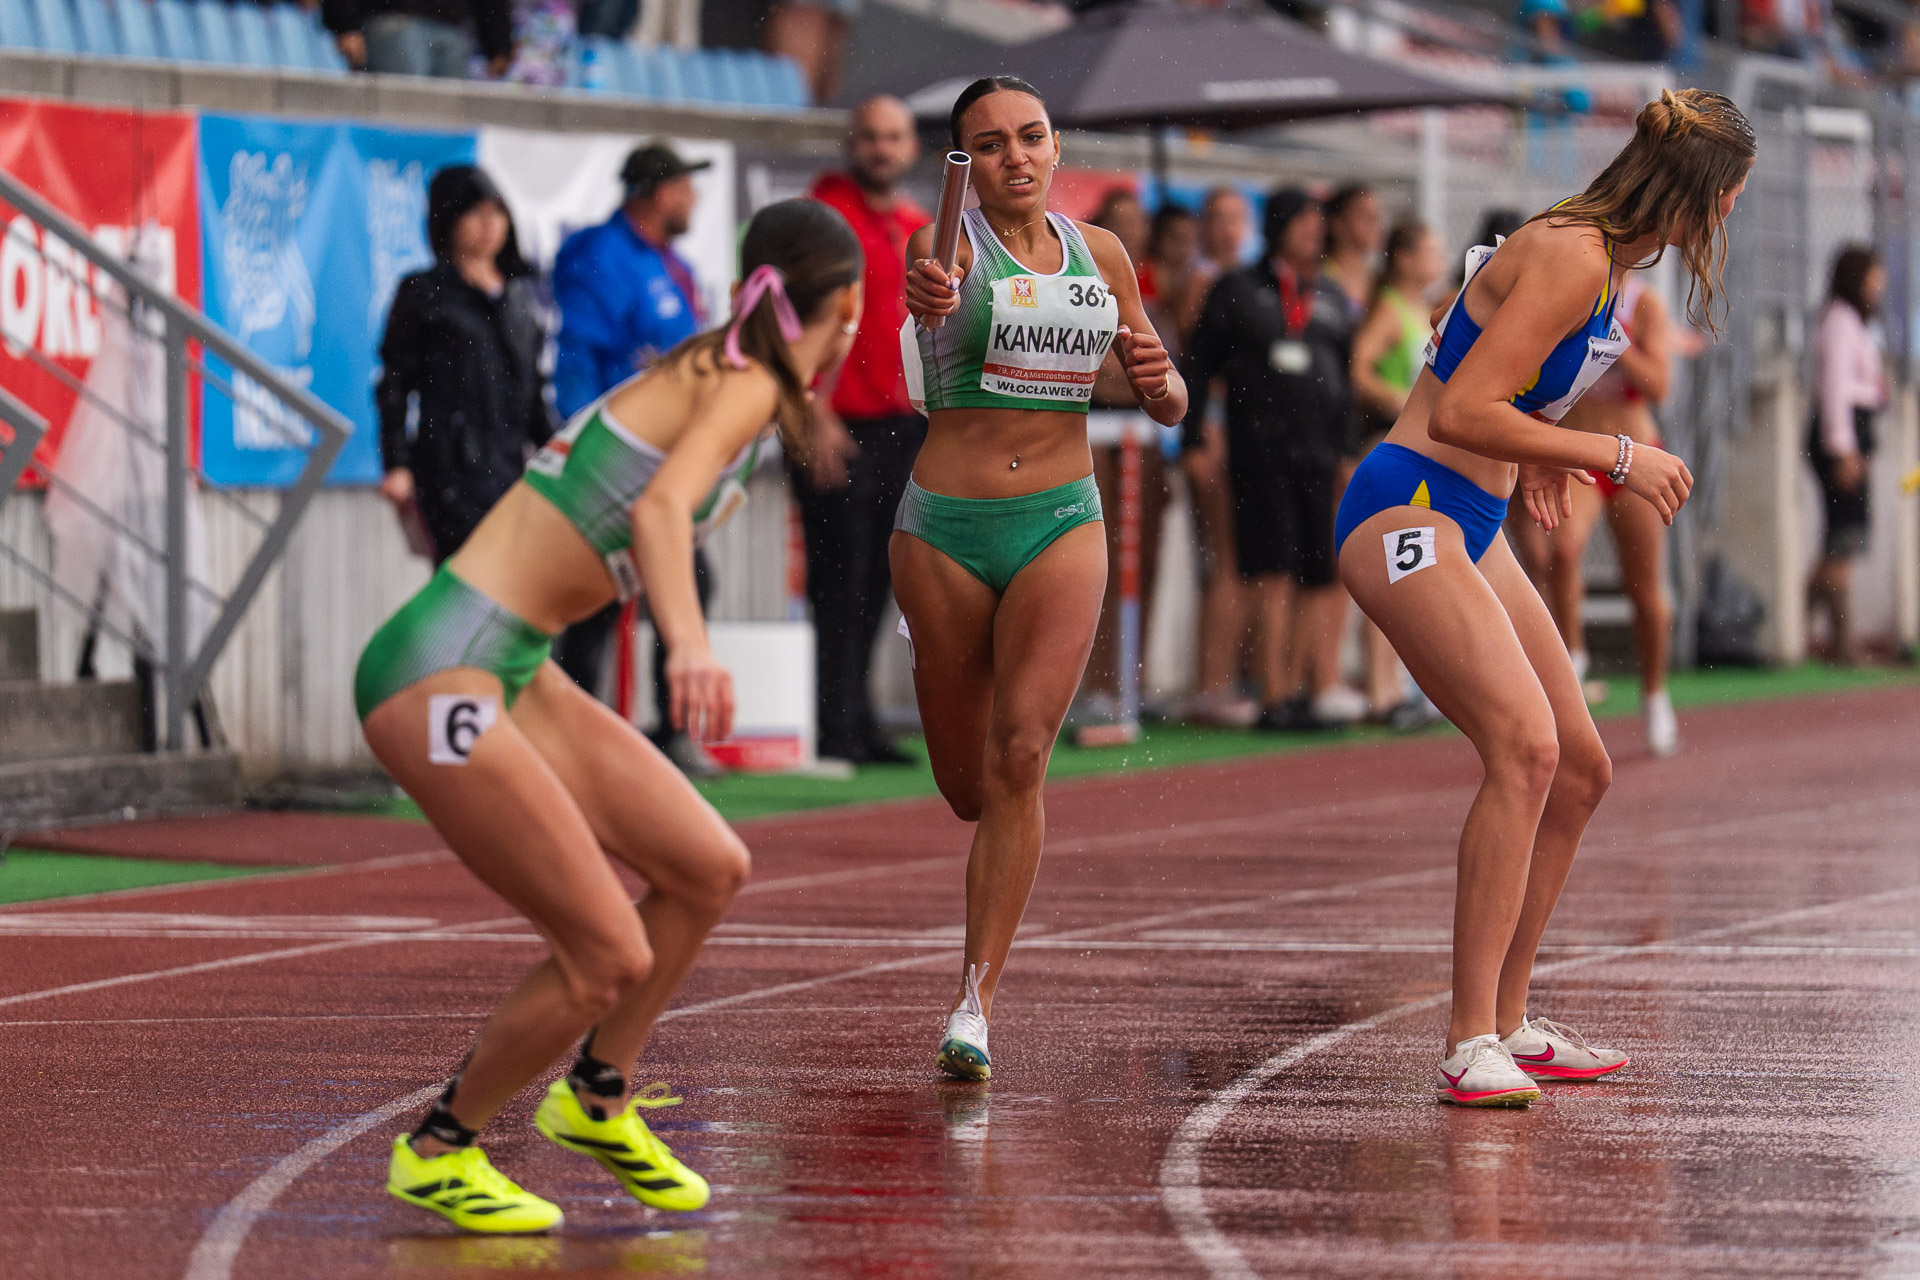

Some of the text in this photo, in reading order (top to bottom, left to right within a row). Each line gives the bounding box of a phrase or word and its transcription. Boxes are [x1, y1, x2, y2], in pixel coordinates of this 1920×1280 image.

[997, 380, 1091, 398] WŁOCŁAWEK 20
[1029, 371, 1071, 381] Mistrzostwa
[1396, 530, 1423, 571] 5
[447, 702, 480, 758] 6
